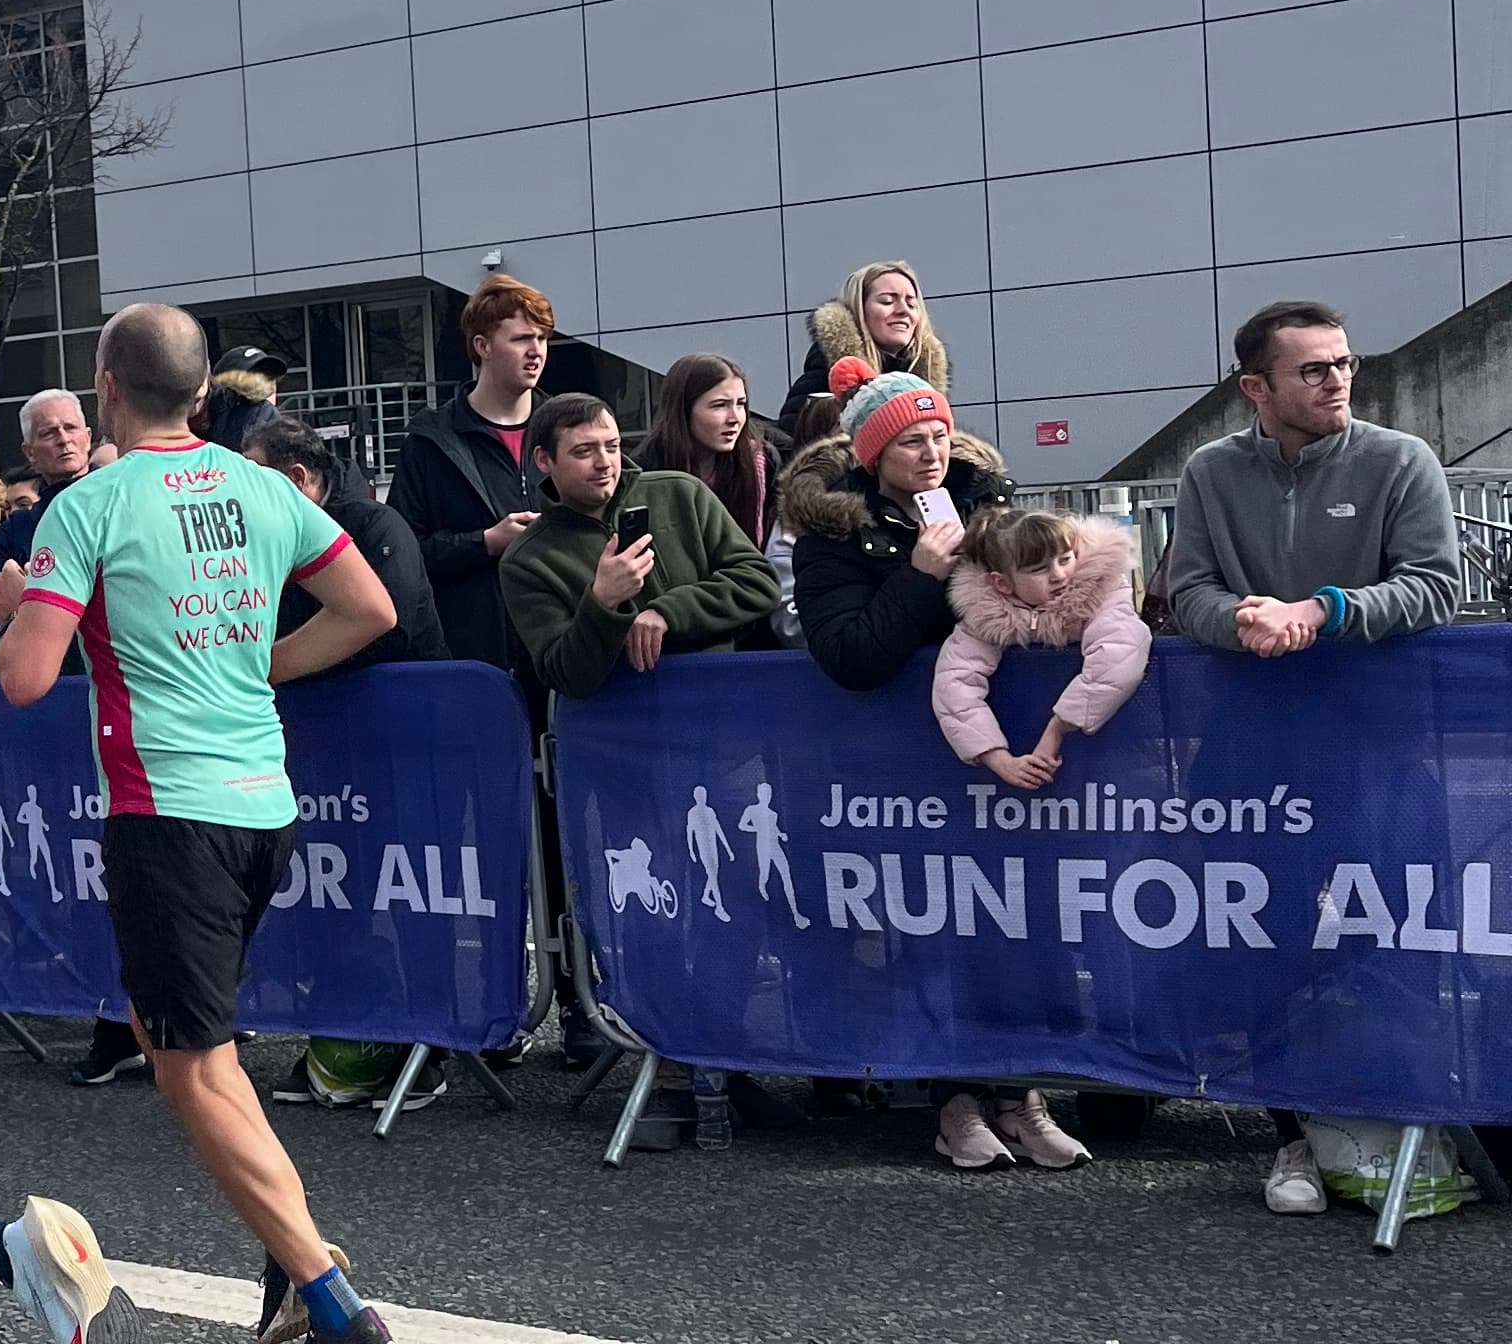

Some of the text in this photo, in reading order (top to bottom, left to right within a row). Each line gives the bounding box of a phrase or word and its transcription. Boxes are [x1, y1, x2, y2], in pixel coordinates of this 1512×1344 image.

[170, 498, 247, 554] TRIB3
[191, 554, 248, 581] I CAN
[168, 586, 267, 618] YOU CAN
[174, 620, 264, 652] WE CAN!
[820, 782, 1314, 834] Jane Tomlinson's
[372, 843, 496, 918] ALL
[822, 851, 1512, 956] RUN FOR ALL
